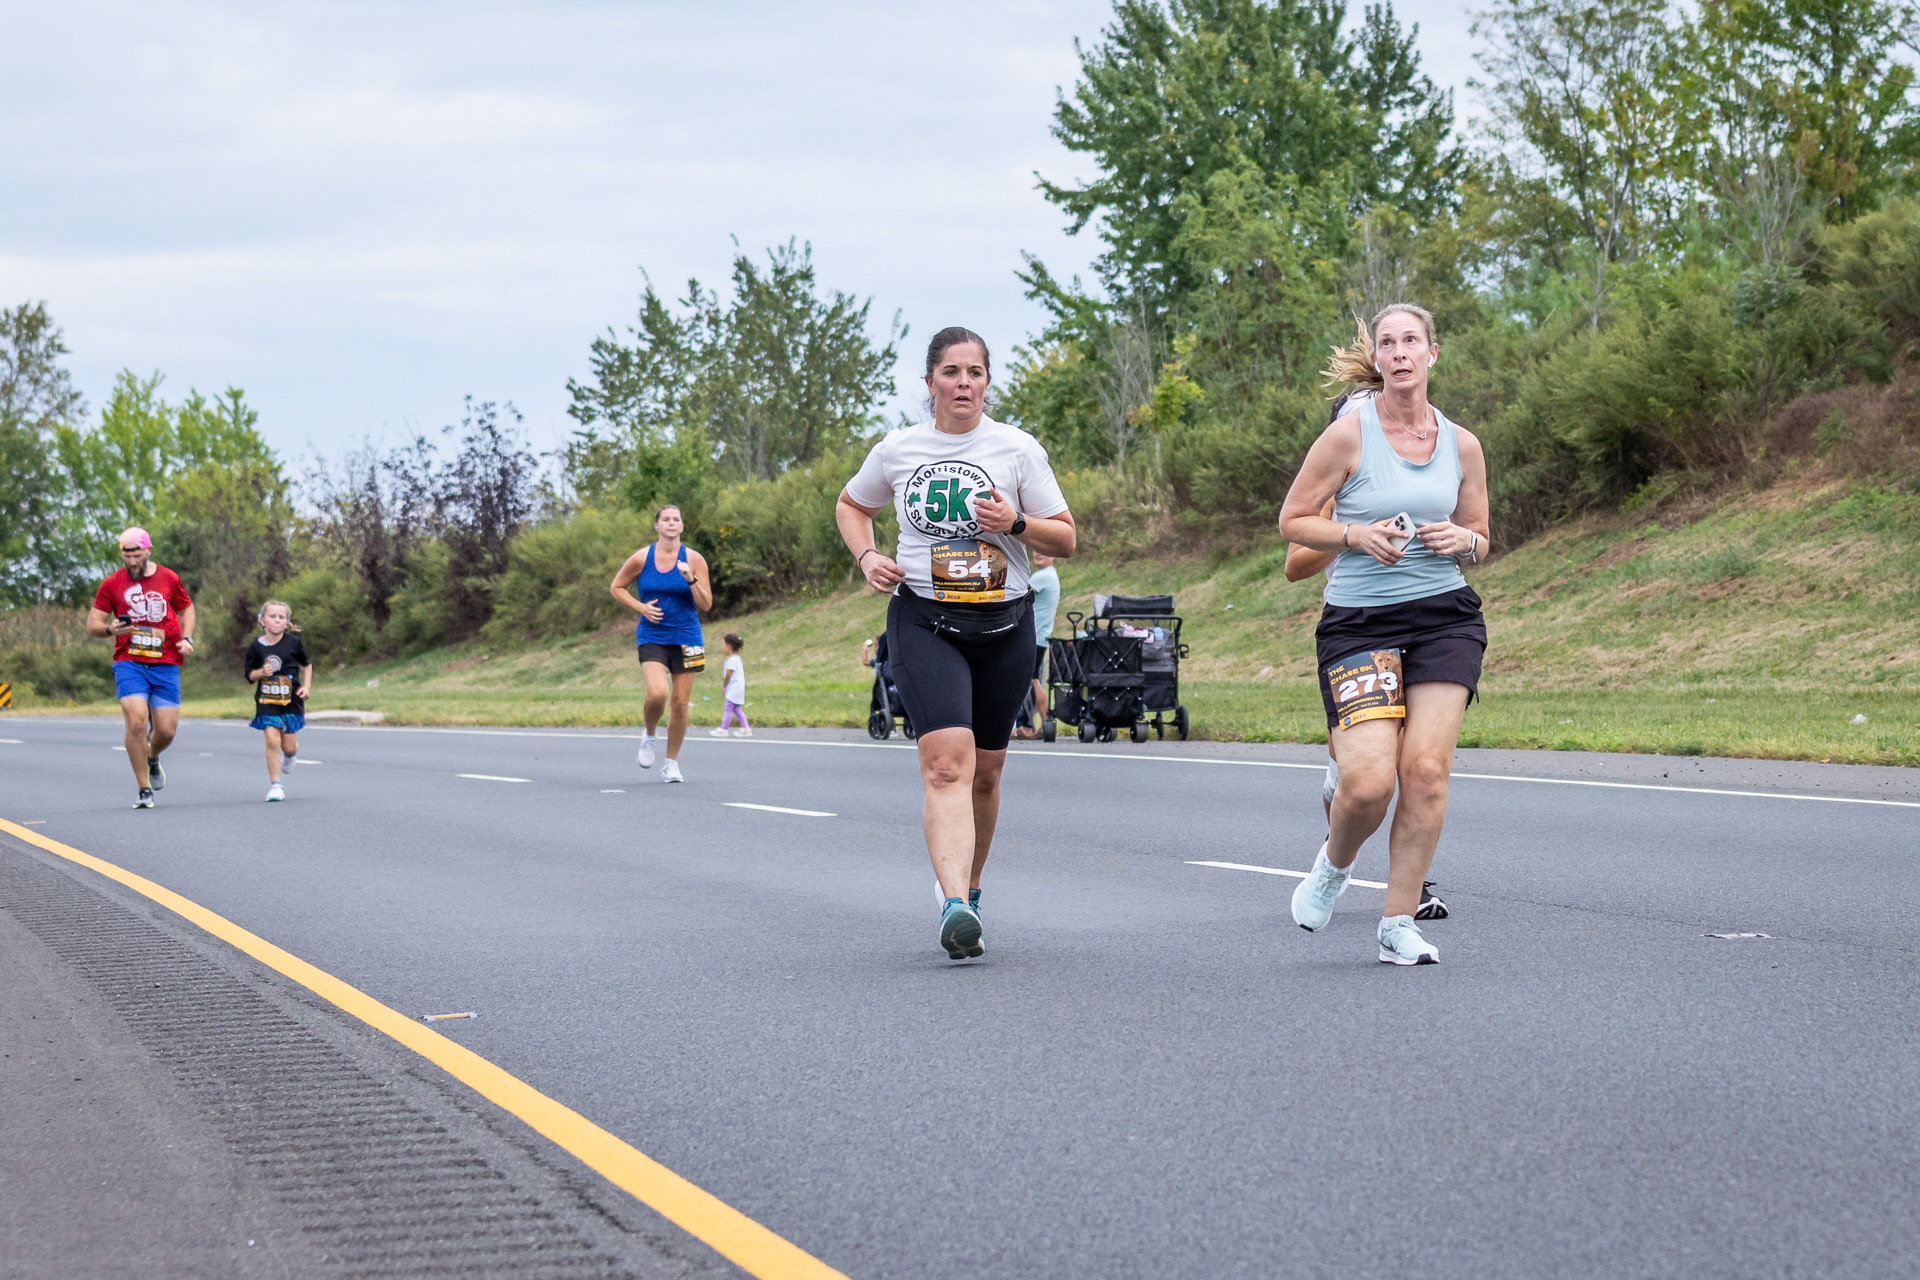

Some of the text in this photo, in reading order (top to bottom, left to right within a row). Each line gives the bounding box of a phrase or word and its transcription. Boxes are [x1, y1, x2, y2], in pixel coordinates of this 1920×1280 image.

[912, 465, 986, 488] Morristown
[910, 509, 922, 526] St.
[932, 544, 950, 552] THE
[932, 551, 963, 559] CHASE
[947, 560, 992, 578] 54
[685, 646, 704, 656] 35
[1329, 665, 1345, 677] THE
[1330, 664, 1374, 685] CHASE 5K
[261, 685, 290, 695] 288
[1338, 671, 1398, 703] 273
